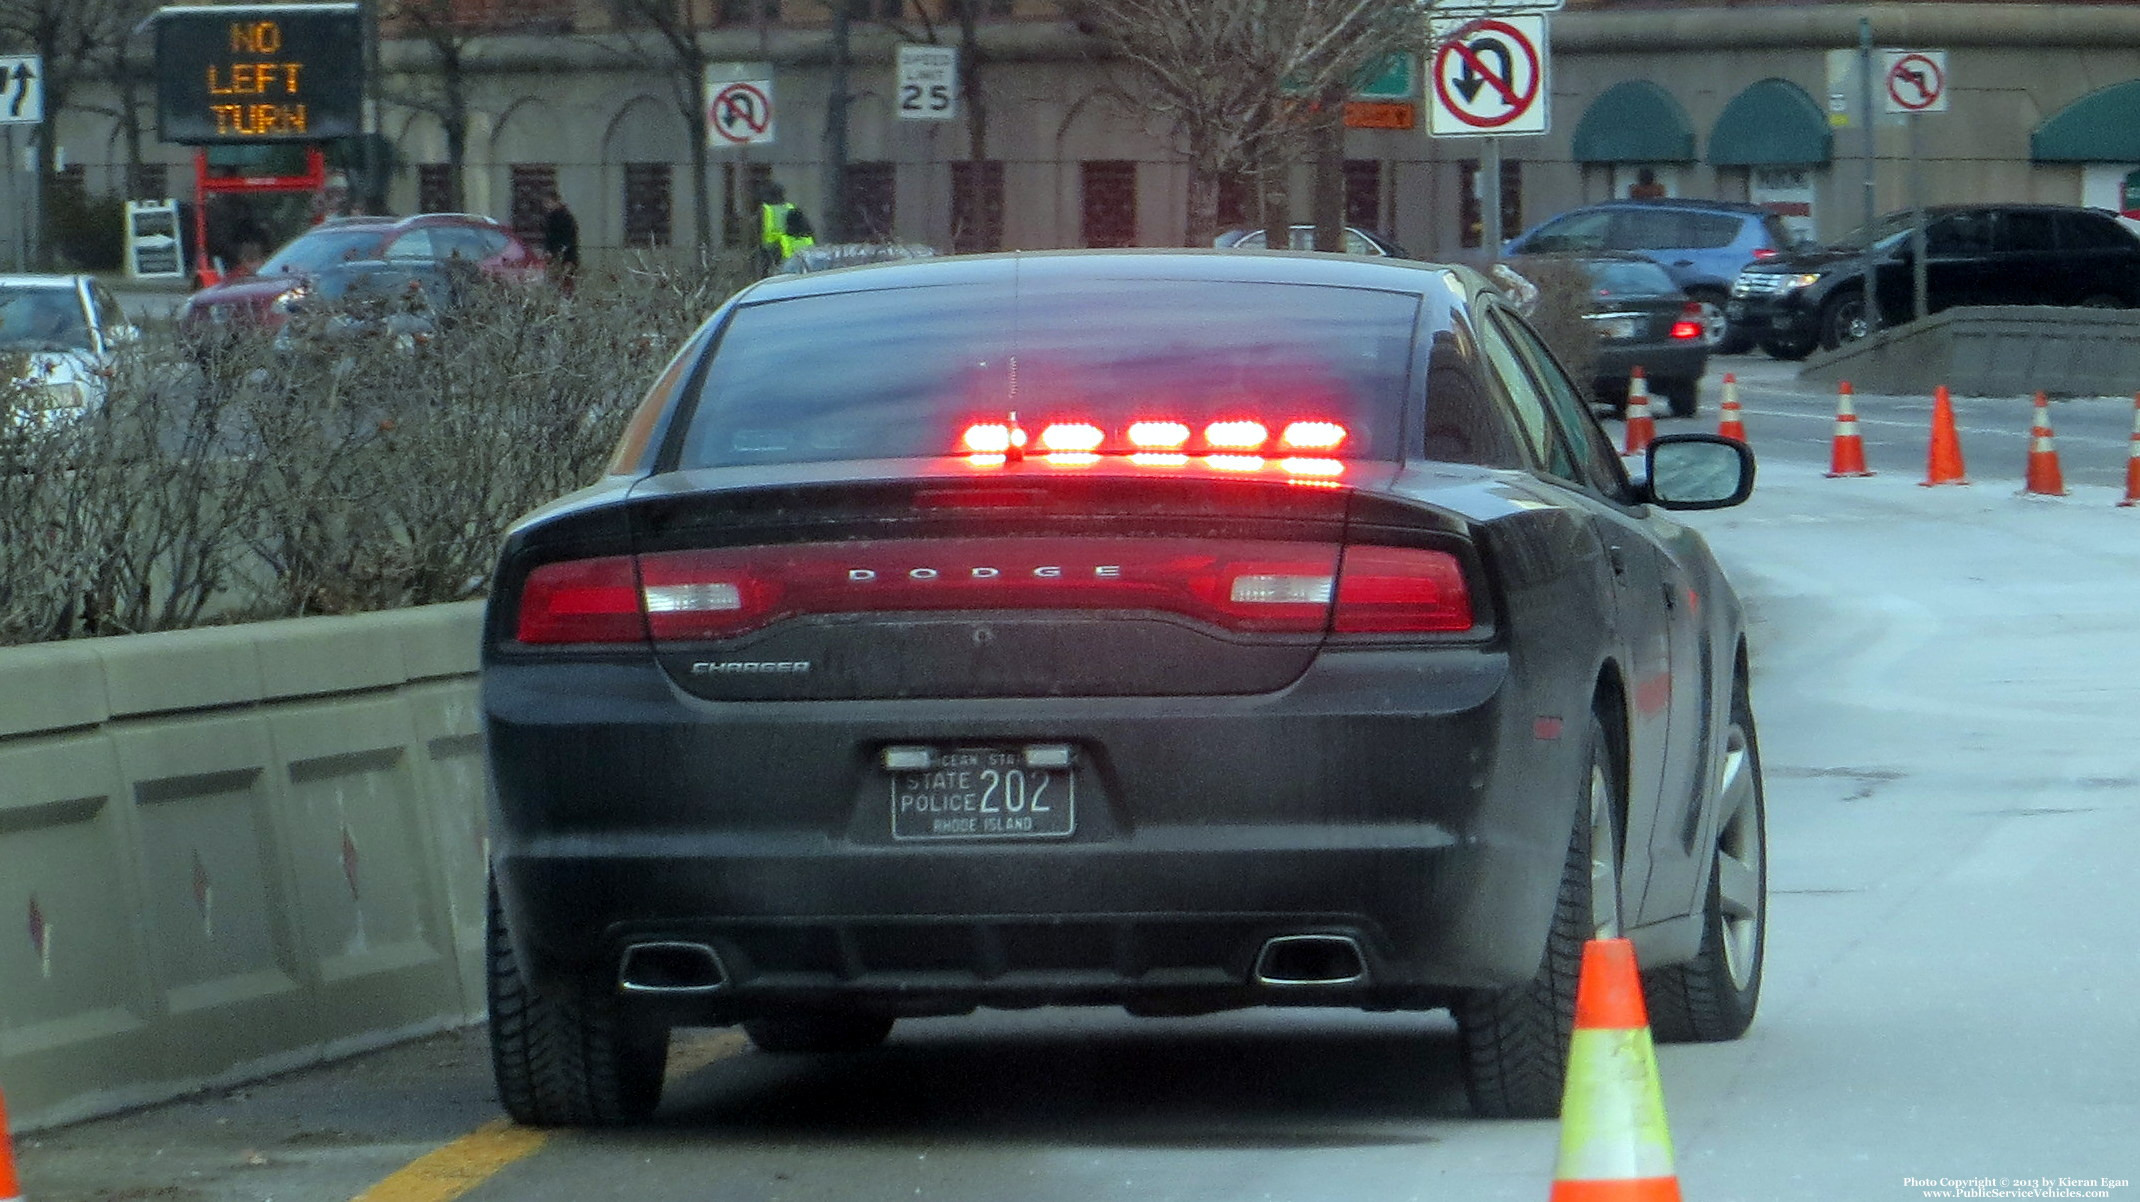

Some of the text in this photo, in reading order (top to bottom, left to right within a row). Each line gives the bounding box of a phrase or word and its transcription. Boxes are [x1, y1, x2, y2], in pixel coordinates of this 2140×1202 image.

[230, 21, 281, 53] NO
[207, 63, 303, 93] LEFT
[902, 85, 949, 110] 25
[209, 104, 307, 134] TURN
[849, 566, 1121, 580] DODGE
[693, 662, 810, 673] CHARGER
[907, 772, 971, 790] STATE
[979, 769, 1050, 813] 202
[901, 793, 977, 813] POLICE
[933, 816, 1033, 833] RHODE ISLAND
